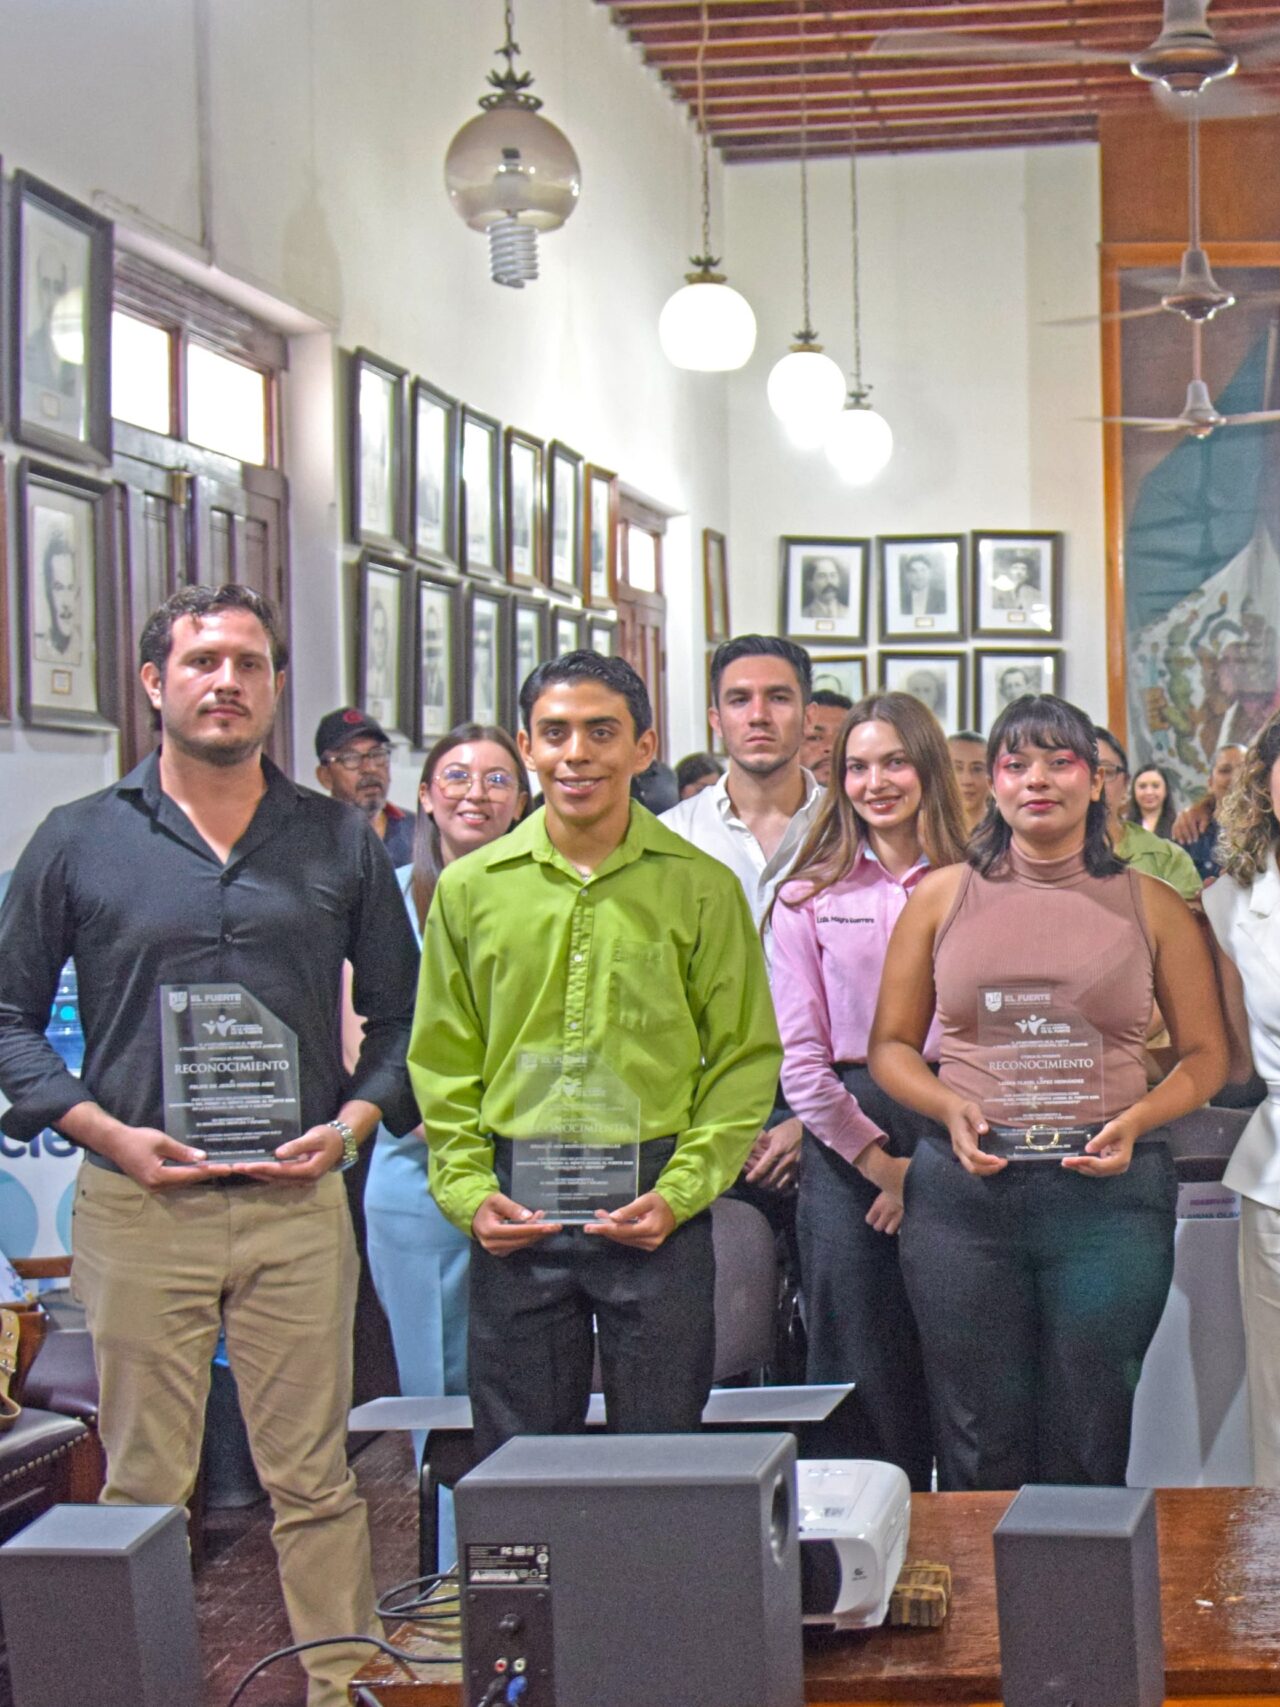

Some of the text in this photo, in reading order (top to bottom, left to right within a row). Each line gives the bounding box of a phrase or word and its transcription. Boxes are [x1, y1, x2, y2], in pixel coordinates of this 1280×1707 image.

[204, 993, 242, 1001] FUERTE
[1018, 993, 1051, 1001] FUERTE
[174, 1060, 290, 1074] RECONOCIMIENTO
[989, 1058, 1094, 1071] RECONOCIMIENTO
[525, 1123, 631, 1135] CONOCIMIENTO
